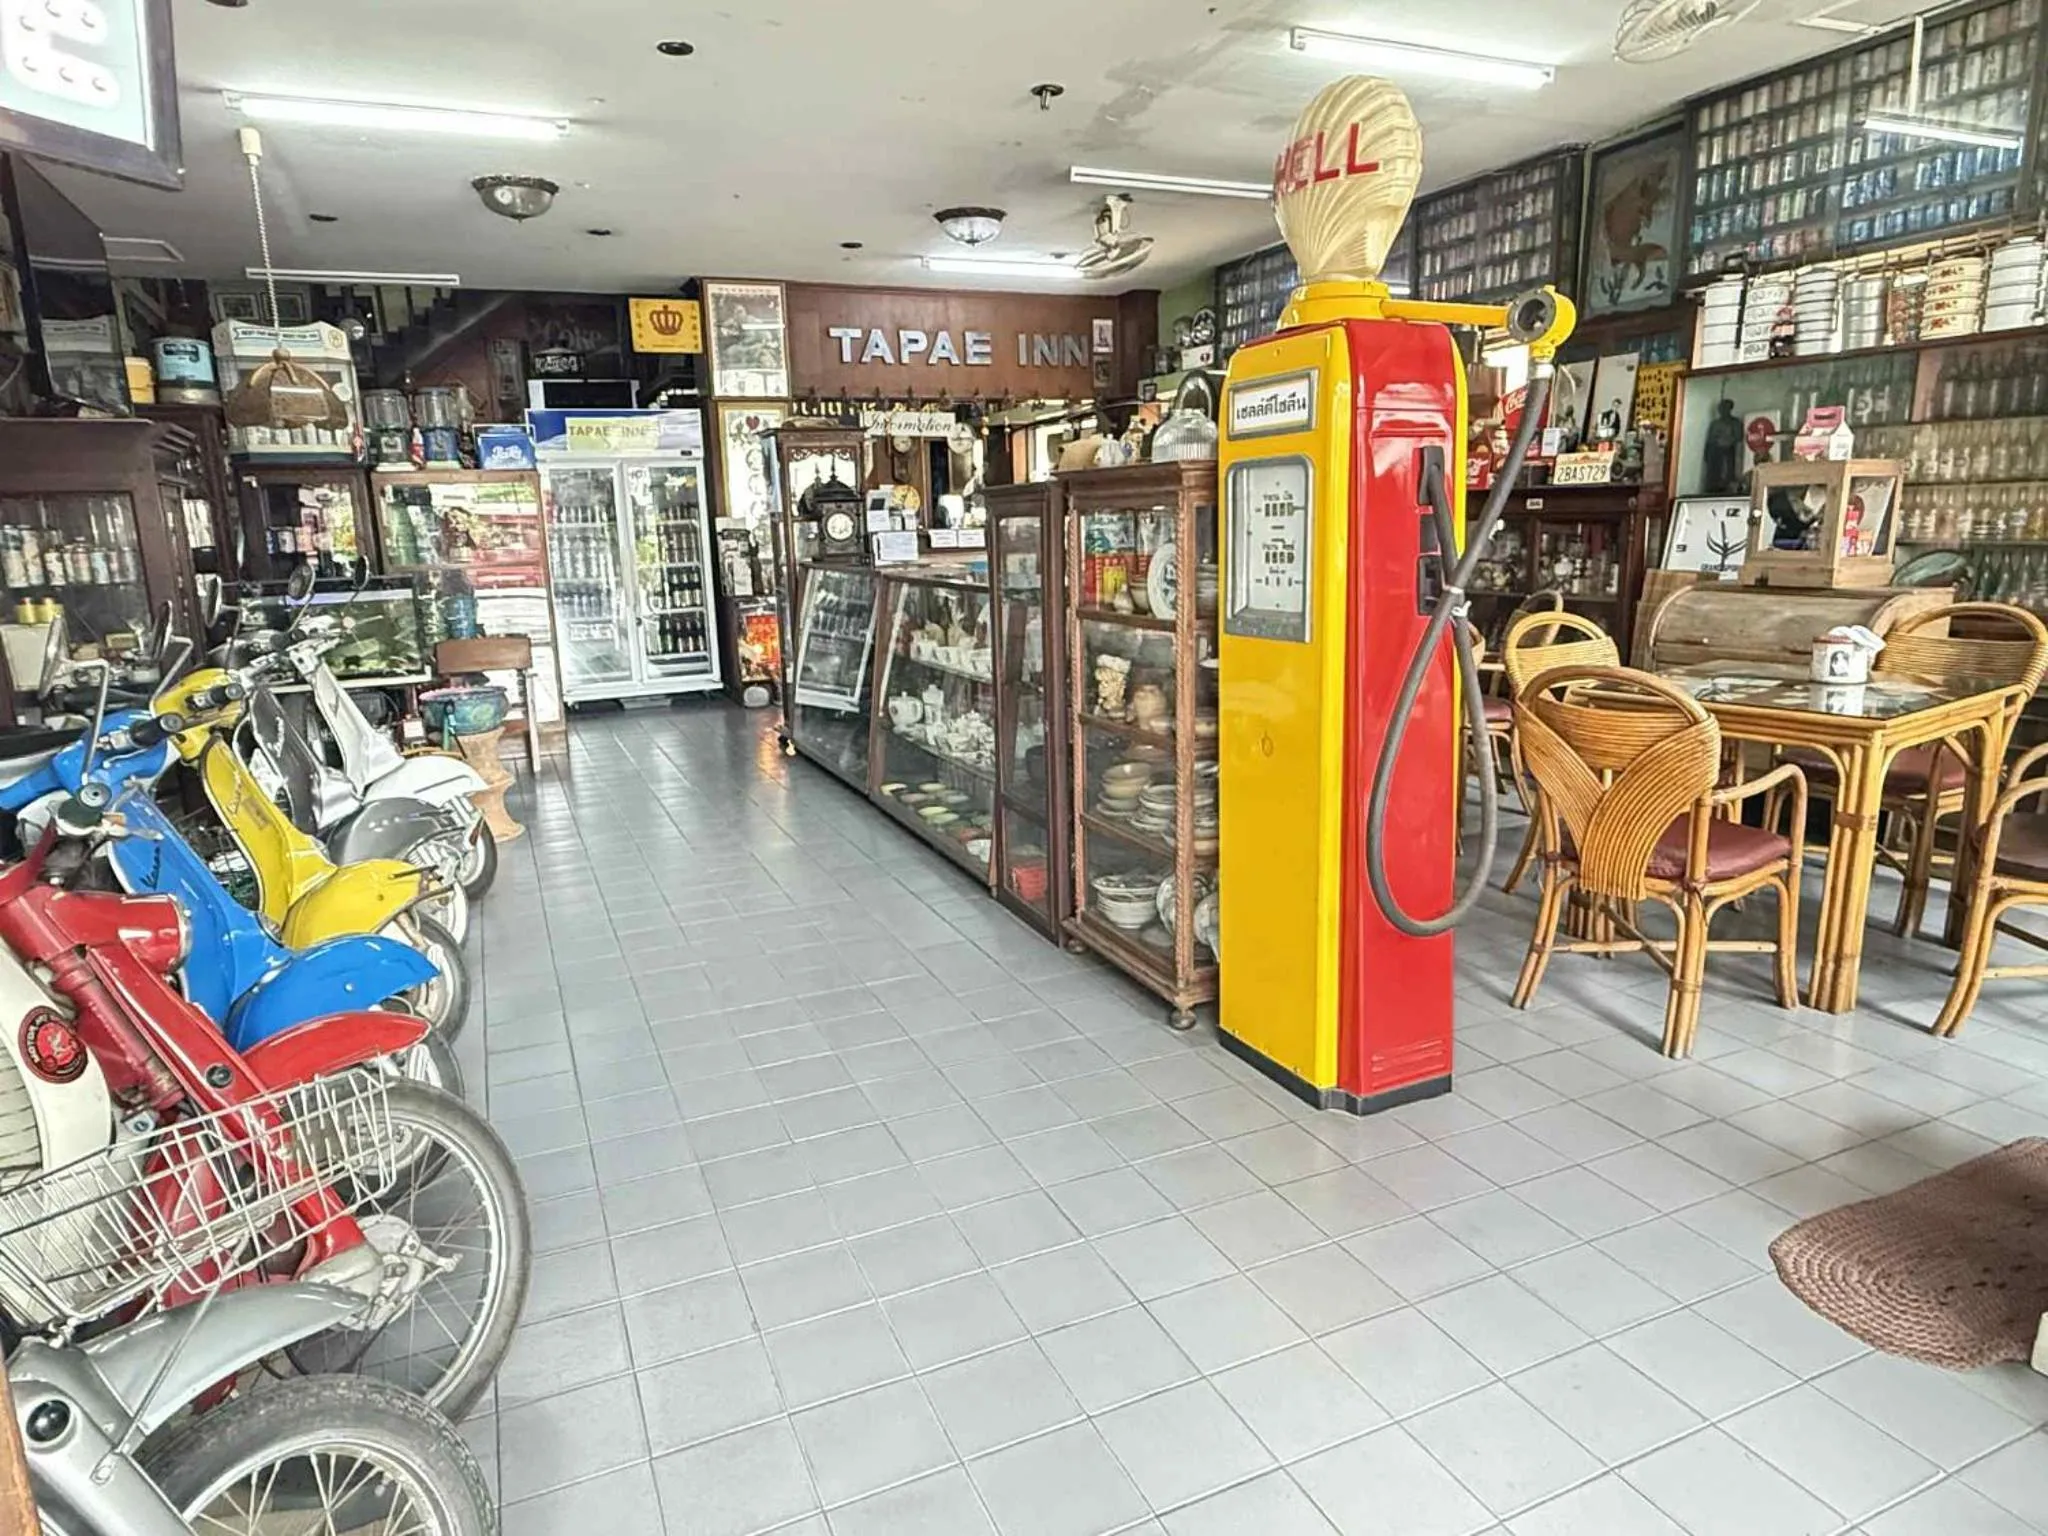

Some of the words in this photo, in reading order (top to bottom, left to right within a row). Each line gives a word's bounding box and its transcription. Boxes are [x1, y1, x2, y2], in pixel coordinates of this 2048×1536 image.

[828, 327, 993, 366] TAPAE
[1016, 332, 1089, 367] INN
[867, 412, 952, 433] Inormation
[569, 425, 609, 437] TAPAE
[1725, 507, 1741, 517] 12
